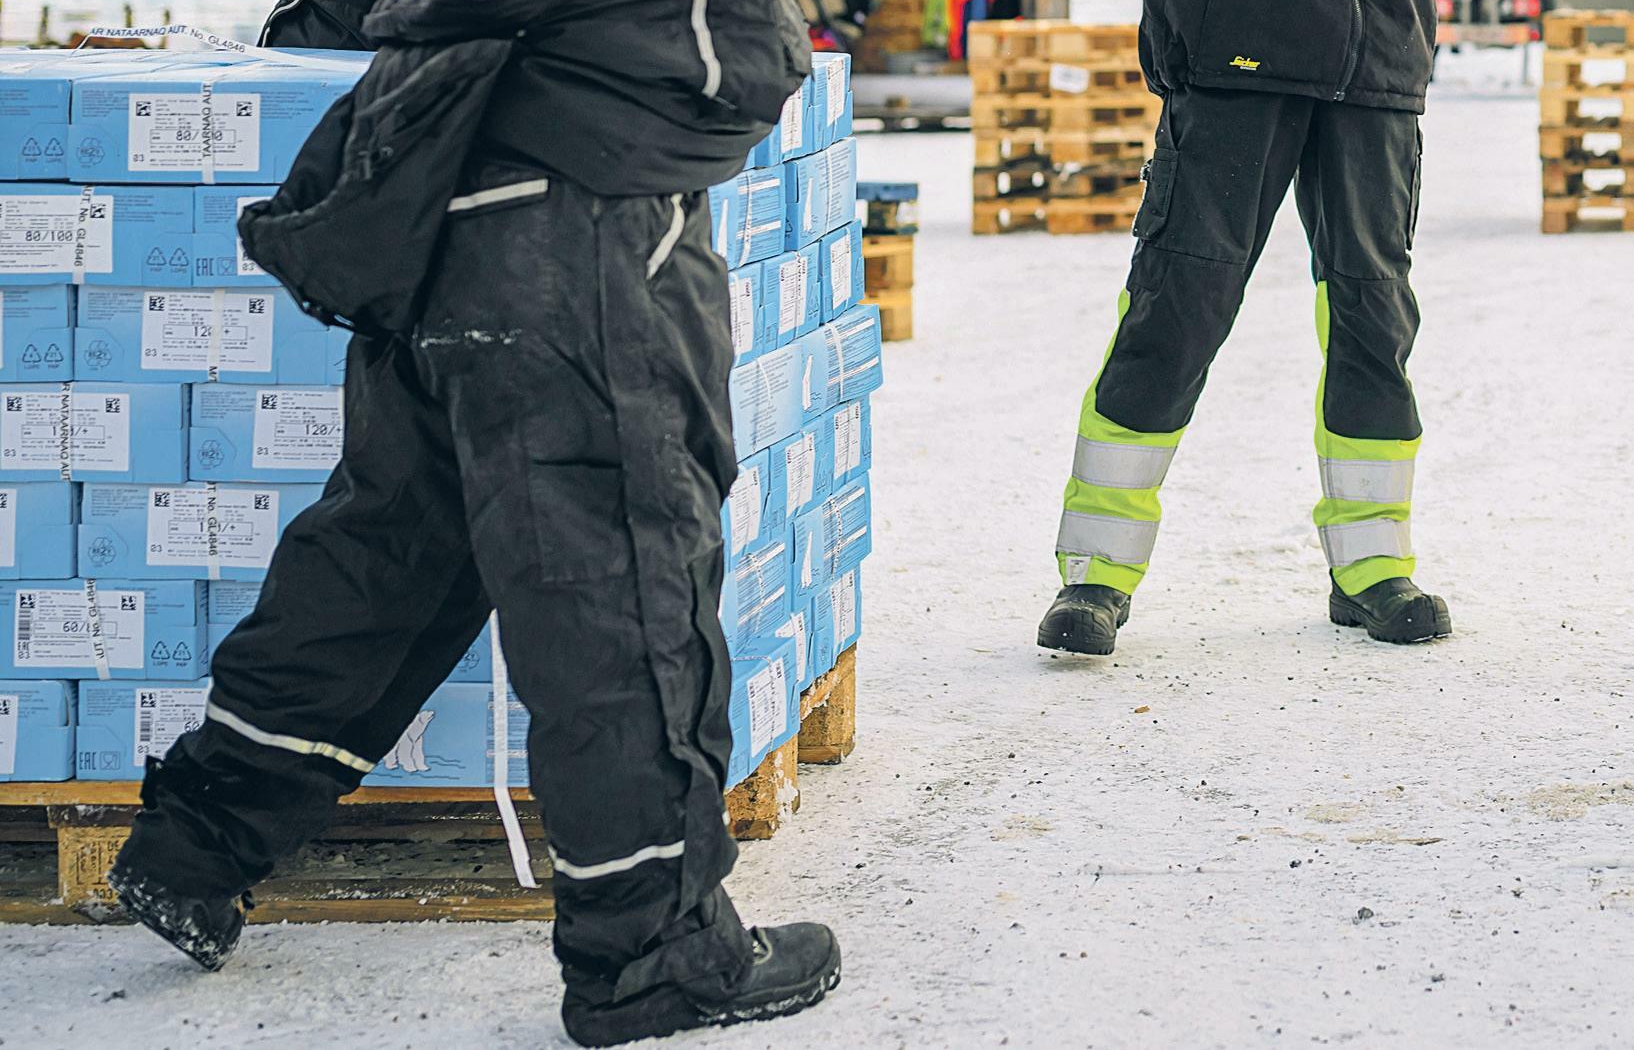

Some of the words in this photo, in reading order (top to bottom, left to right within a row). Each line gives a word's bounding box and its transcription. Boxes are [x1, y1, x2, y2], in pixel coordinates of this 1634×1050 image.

[106, 27, 166, 37] NATAARNAQ
[208, 35, 246, 53] GL4846
[25, 230, 73, 242] 80/100
[207, 516, 218, 557] GL4846
